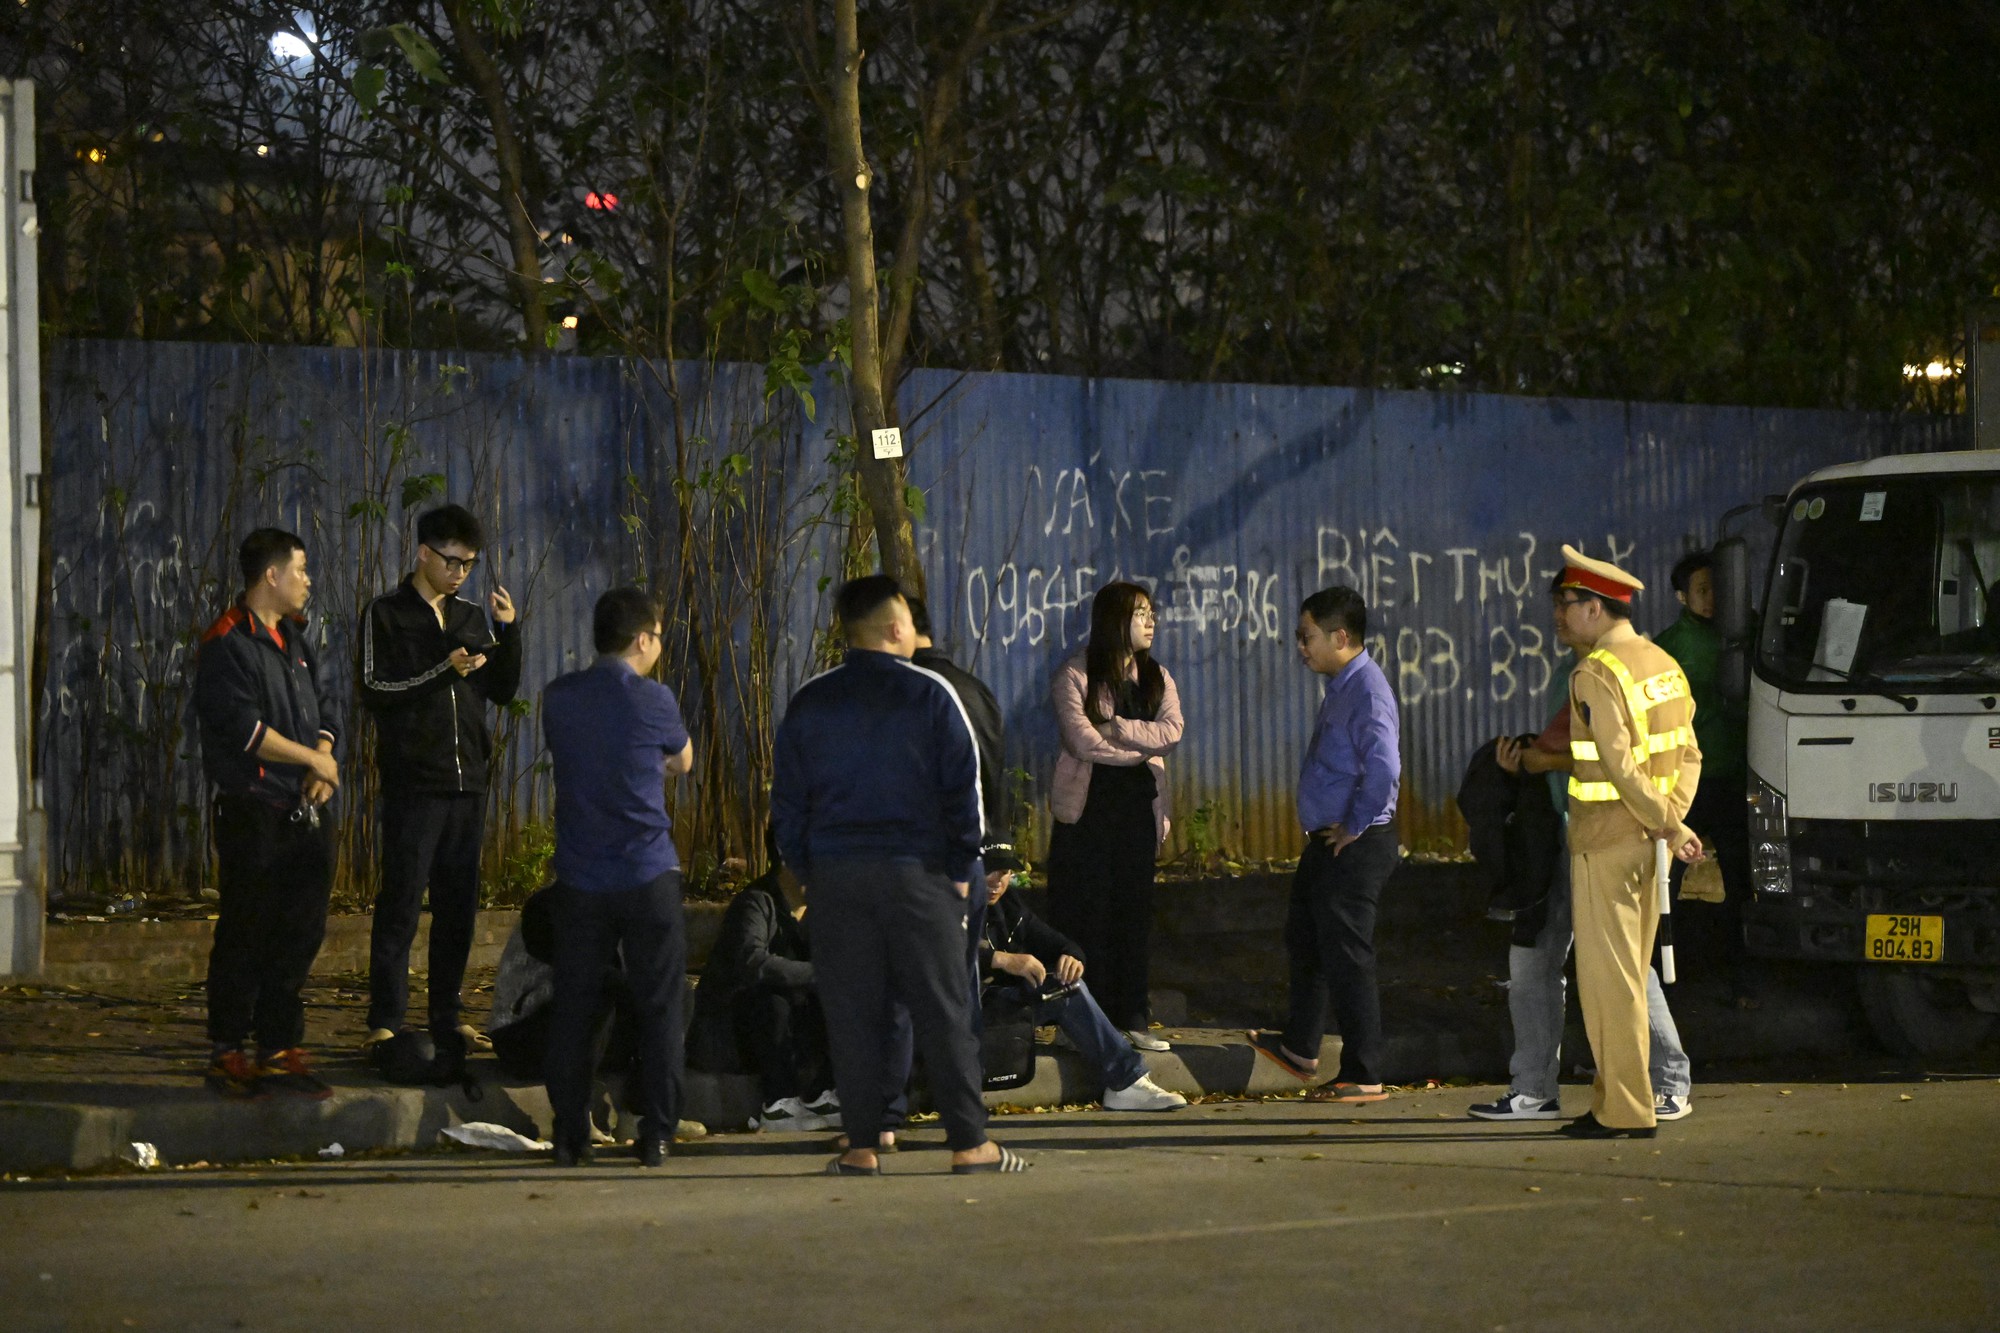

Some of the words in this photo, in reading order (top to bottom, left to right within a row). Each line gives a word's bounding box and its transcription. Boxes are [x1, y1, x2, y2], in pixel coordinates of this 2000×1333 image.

[878, 433, 897, 446] 112
[1109, 469, 1177, 541] XE
[1868, 782, 1958, 803] ISUZU
[1887, 917, 1922, 937] 29H
[1873, 938, 1934, 960] 804.83
[988, 1073, 1018, 1083] LACOSTE
